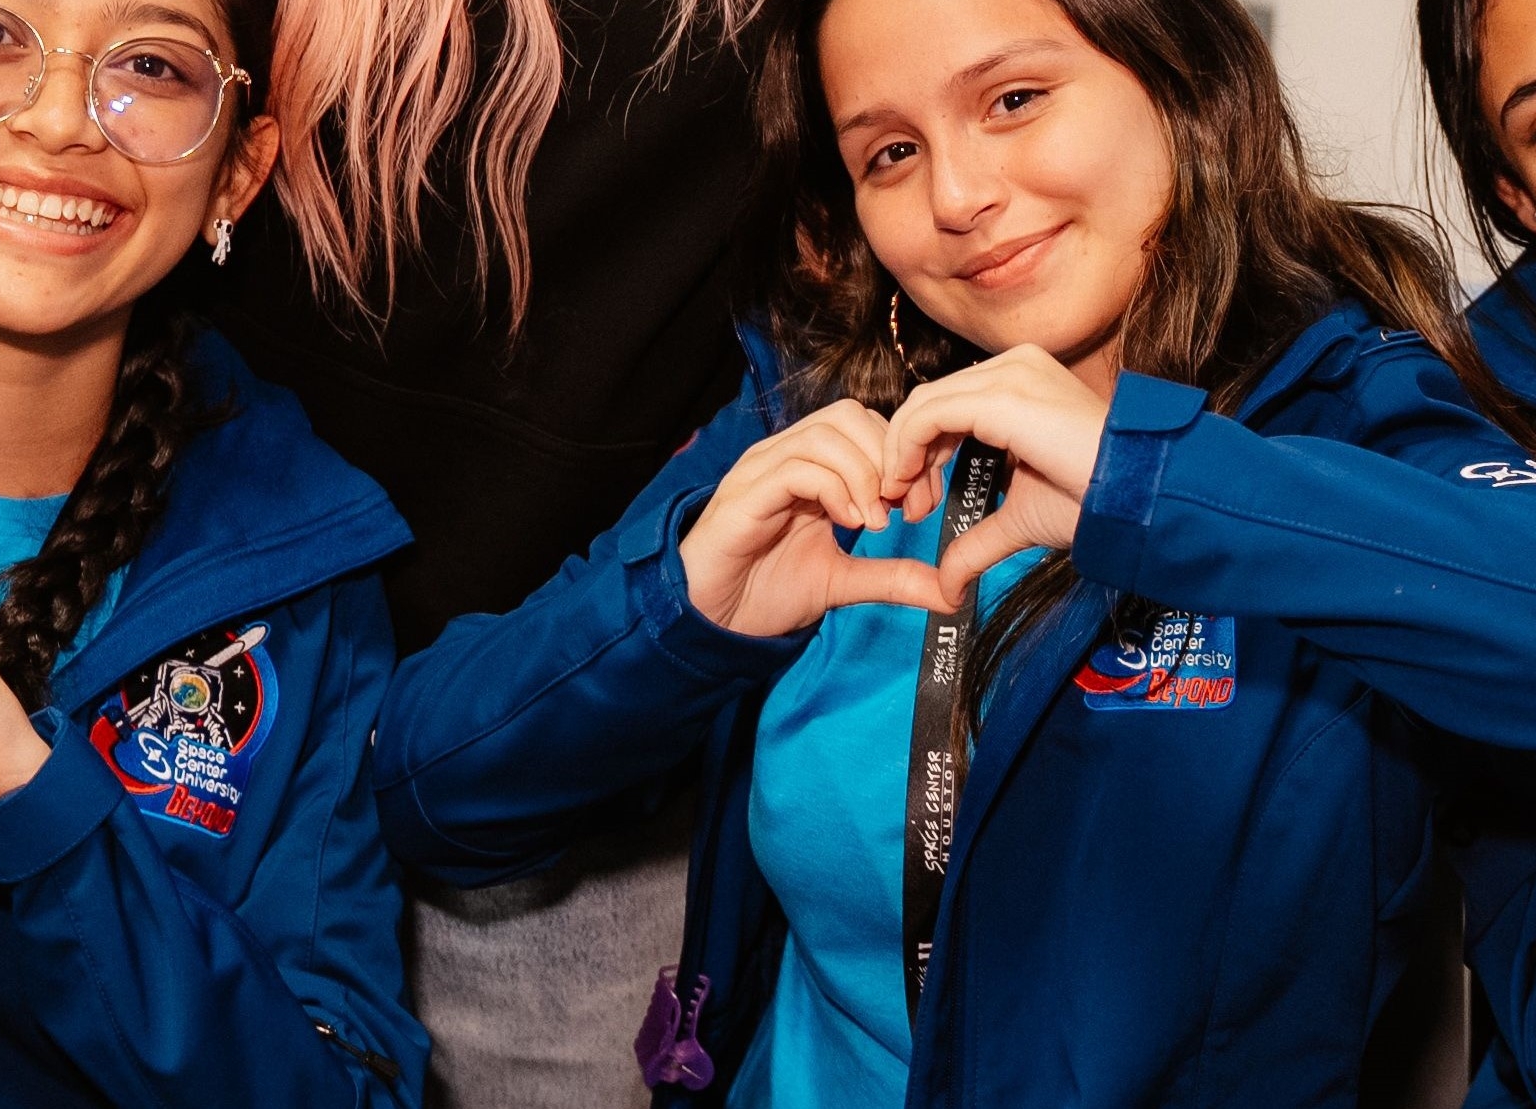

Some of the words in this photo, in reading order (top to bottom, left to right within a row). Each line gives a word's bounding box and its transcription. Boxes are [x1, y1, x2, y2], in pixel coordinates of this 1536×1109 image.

[962, 456, 983, 509] CENTER
[973, 458, 994, 520] USTON
[927, 648, 948, 686] SPACE
[174, 755, 228, 779] Center
[177, 737, 225, 764] Space
[173, 767, 241, 805] University
[925, 750, 942, 814] CENTER
[942, 752, 953, 863] HOUSTON
[911, 818, 945, 875] SPACE
